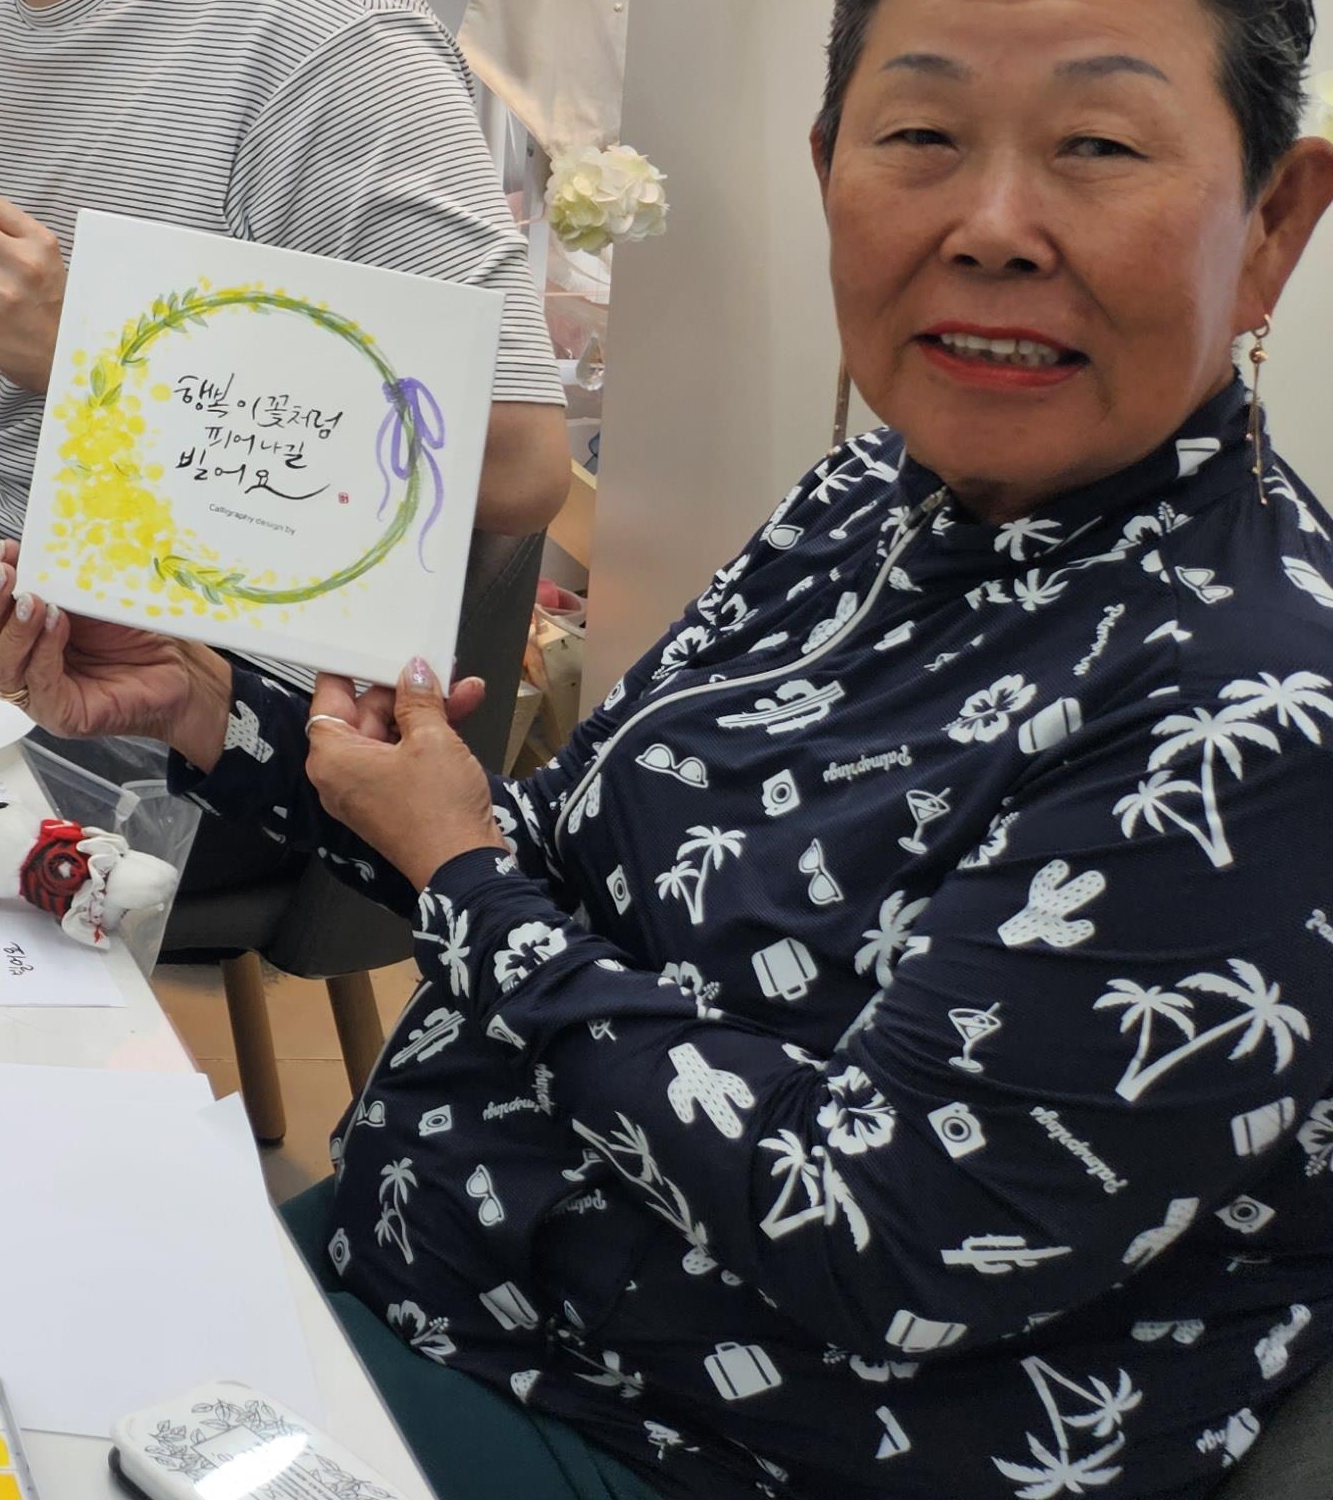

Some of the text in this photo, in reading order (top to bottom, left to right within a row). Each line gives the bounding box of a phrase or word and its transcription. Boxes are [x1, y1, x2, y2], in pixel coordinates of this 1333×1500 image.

[204, 426, 309, 470] 피어나길
[175, 448, 331, 501] 빌어요
[208, 503, 297, 536] Calligraphy design by
